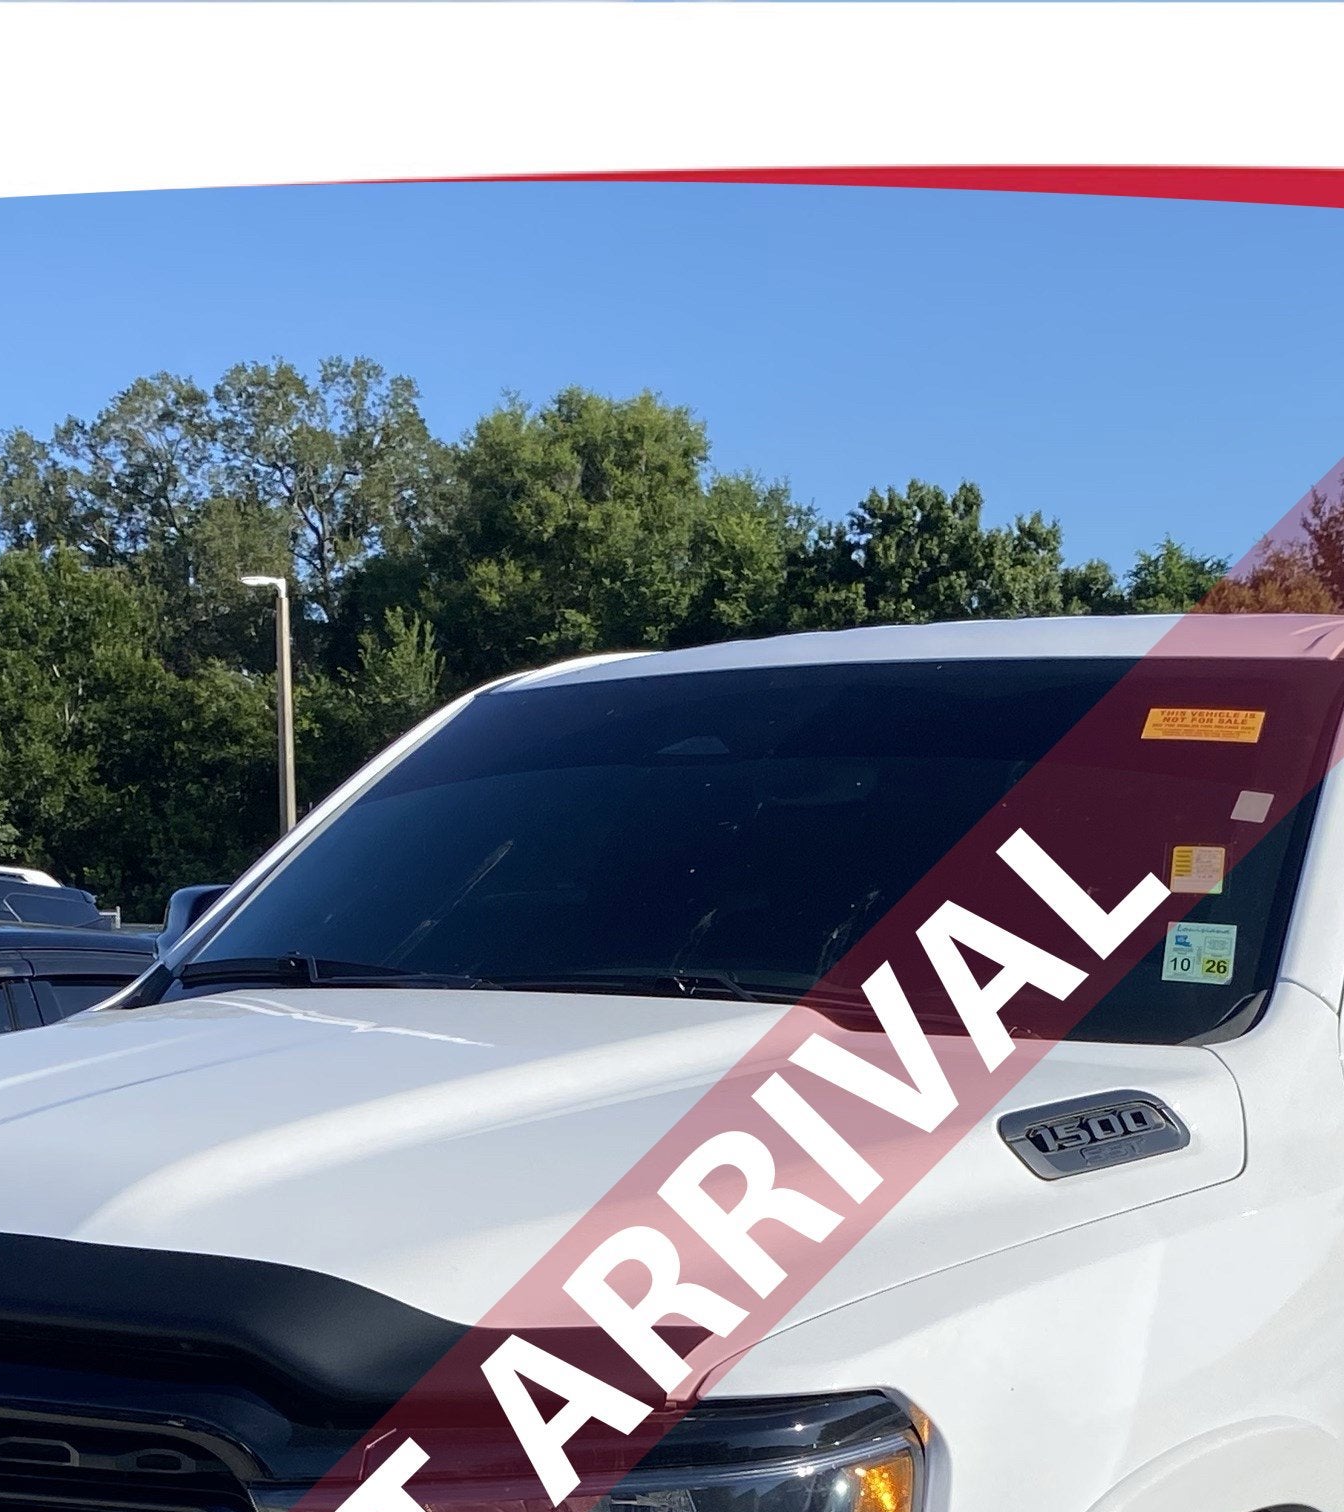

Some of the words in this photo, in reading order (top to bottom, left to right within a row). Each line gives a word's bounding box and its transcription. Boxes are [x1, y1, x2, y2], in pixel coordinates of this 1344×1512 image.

[1170, 957, 1191, 972] 10
[1205, 959, 1227, 974] 26
[1029, 1107, 1154, 1152] 1500
